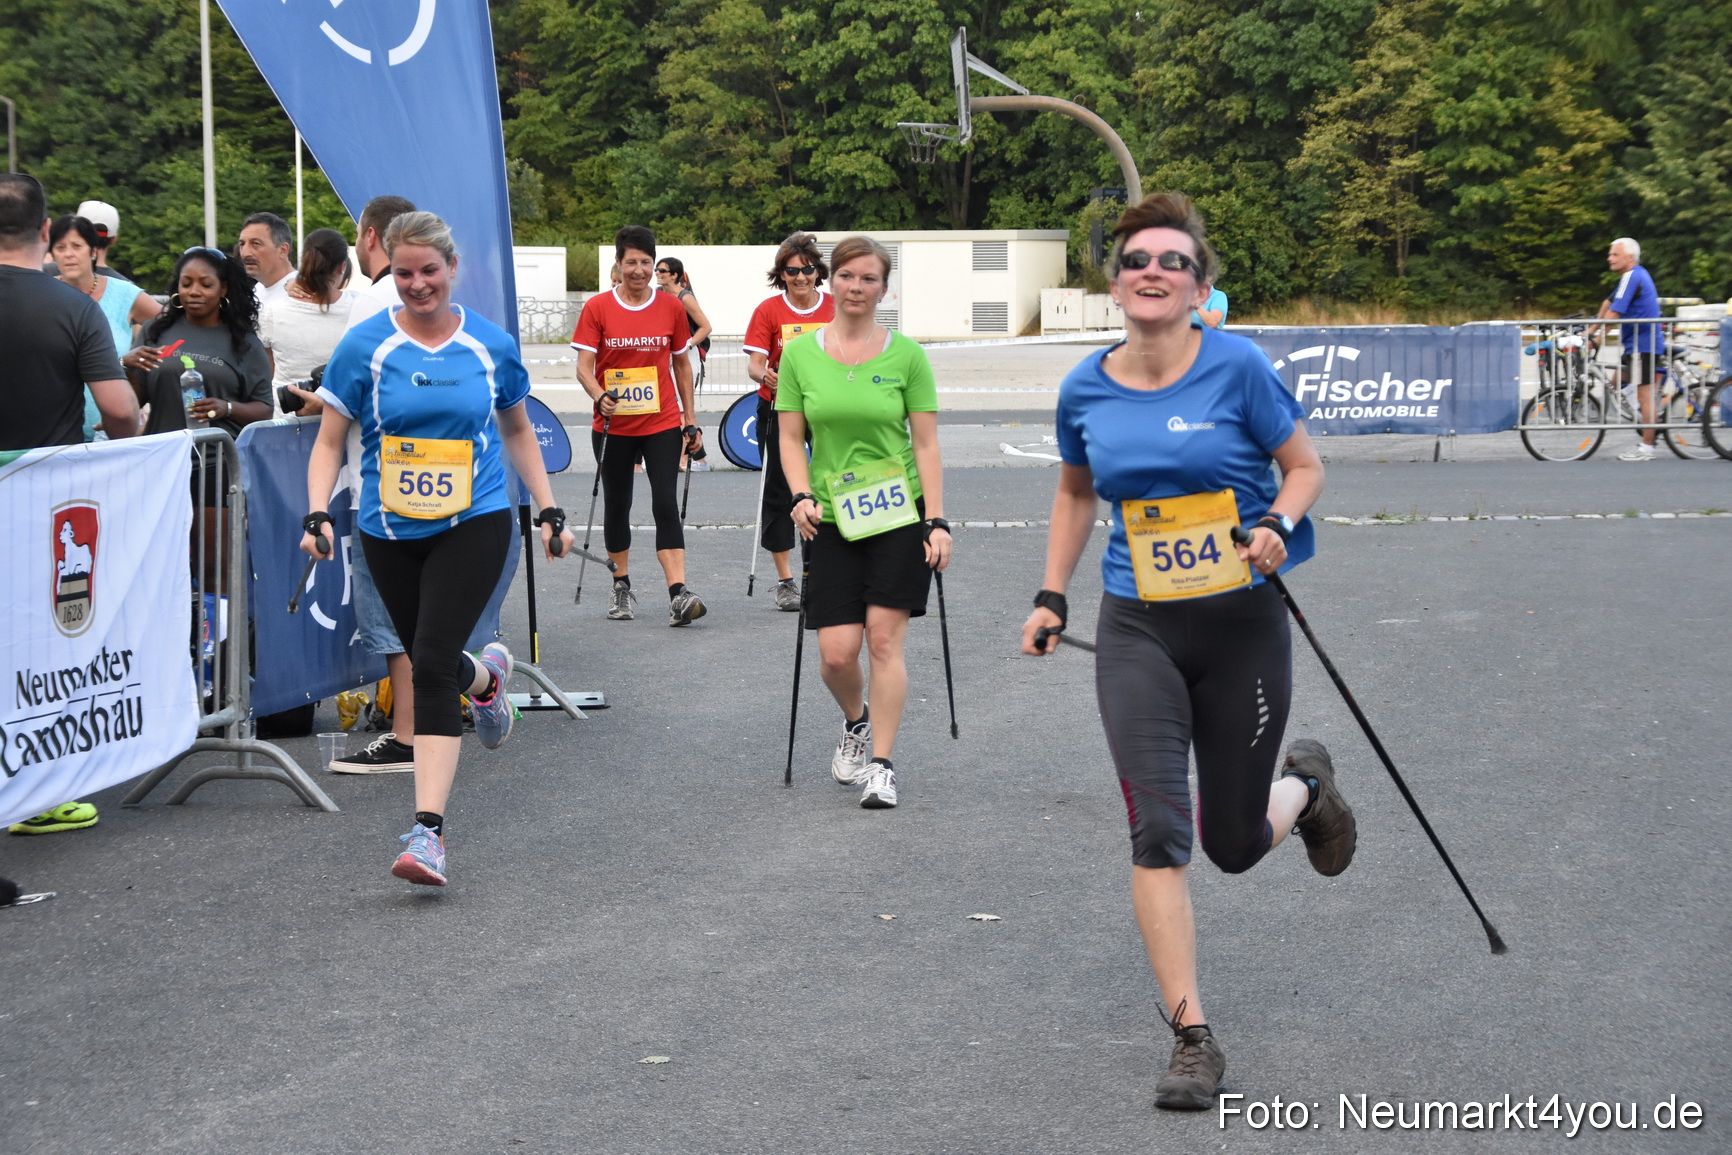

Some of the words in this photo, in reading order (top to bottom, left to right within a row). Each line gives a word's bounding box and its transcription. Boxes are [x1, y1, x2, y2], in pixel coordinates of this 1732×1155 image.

[605, 336, 661, 348] NEUMARKT
[433, 379, 460, 387] classic
[1295, 371, 1453, 402] Fischer
[1308, 405, 1440, 420] AUTOMOBILE
[398, 470, 453, 498] 565
[841, 484, 906, 520] 1545
[1152, 533, 1222, 572] 564
[62, 603, 83, 624] 1628
